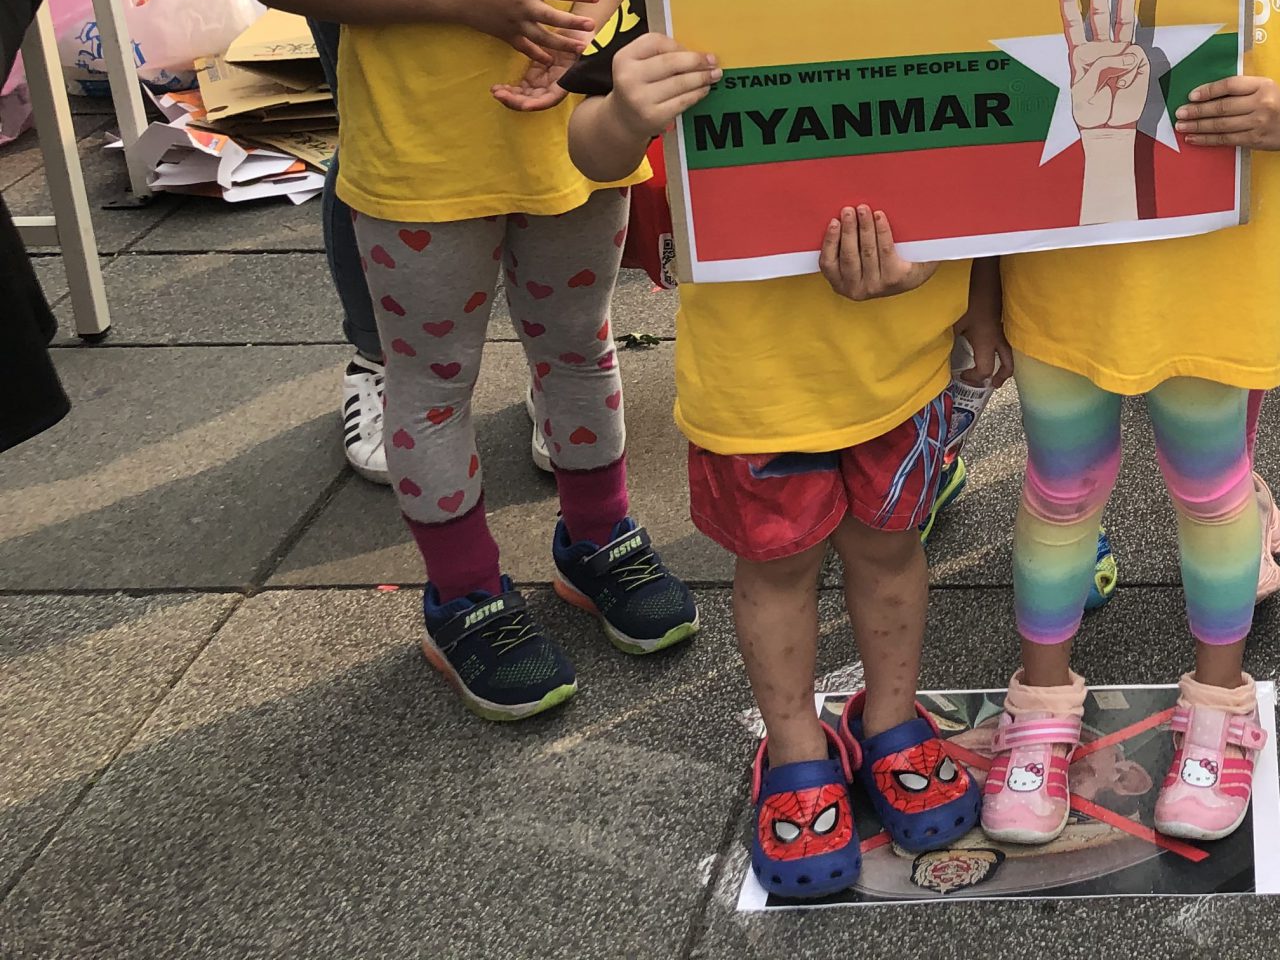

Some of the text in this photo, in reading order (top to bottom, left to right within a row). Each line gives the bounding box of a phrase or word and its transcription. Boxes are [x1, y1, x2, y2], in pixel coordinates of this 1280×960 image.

[724, 72, 793, 91] STAND
[797, 68, 850, 84] WITH
[857, 64, 897, 80] THE
[903, 59, 980, 77] PEOPLE
[985, 58, 1011, 71] OF
[693, 92, 1015, 152] MYANMAR
[608, 535, 643, 562] JESTER
[464, 599, 505, 630] JESTER
